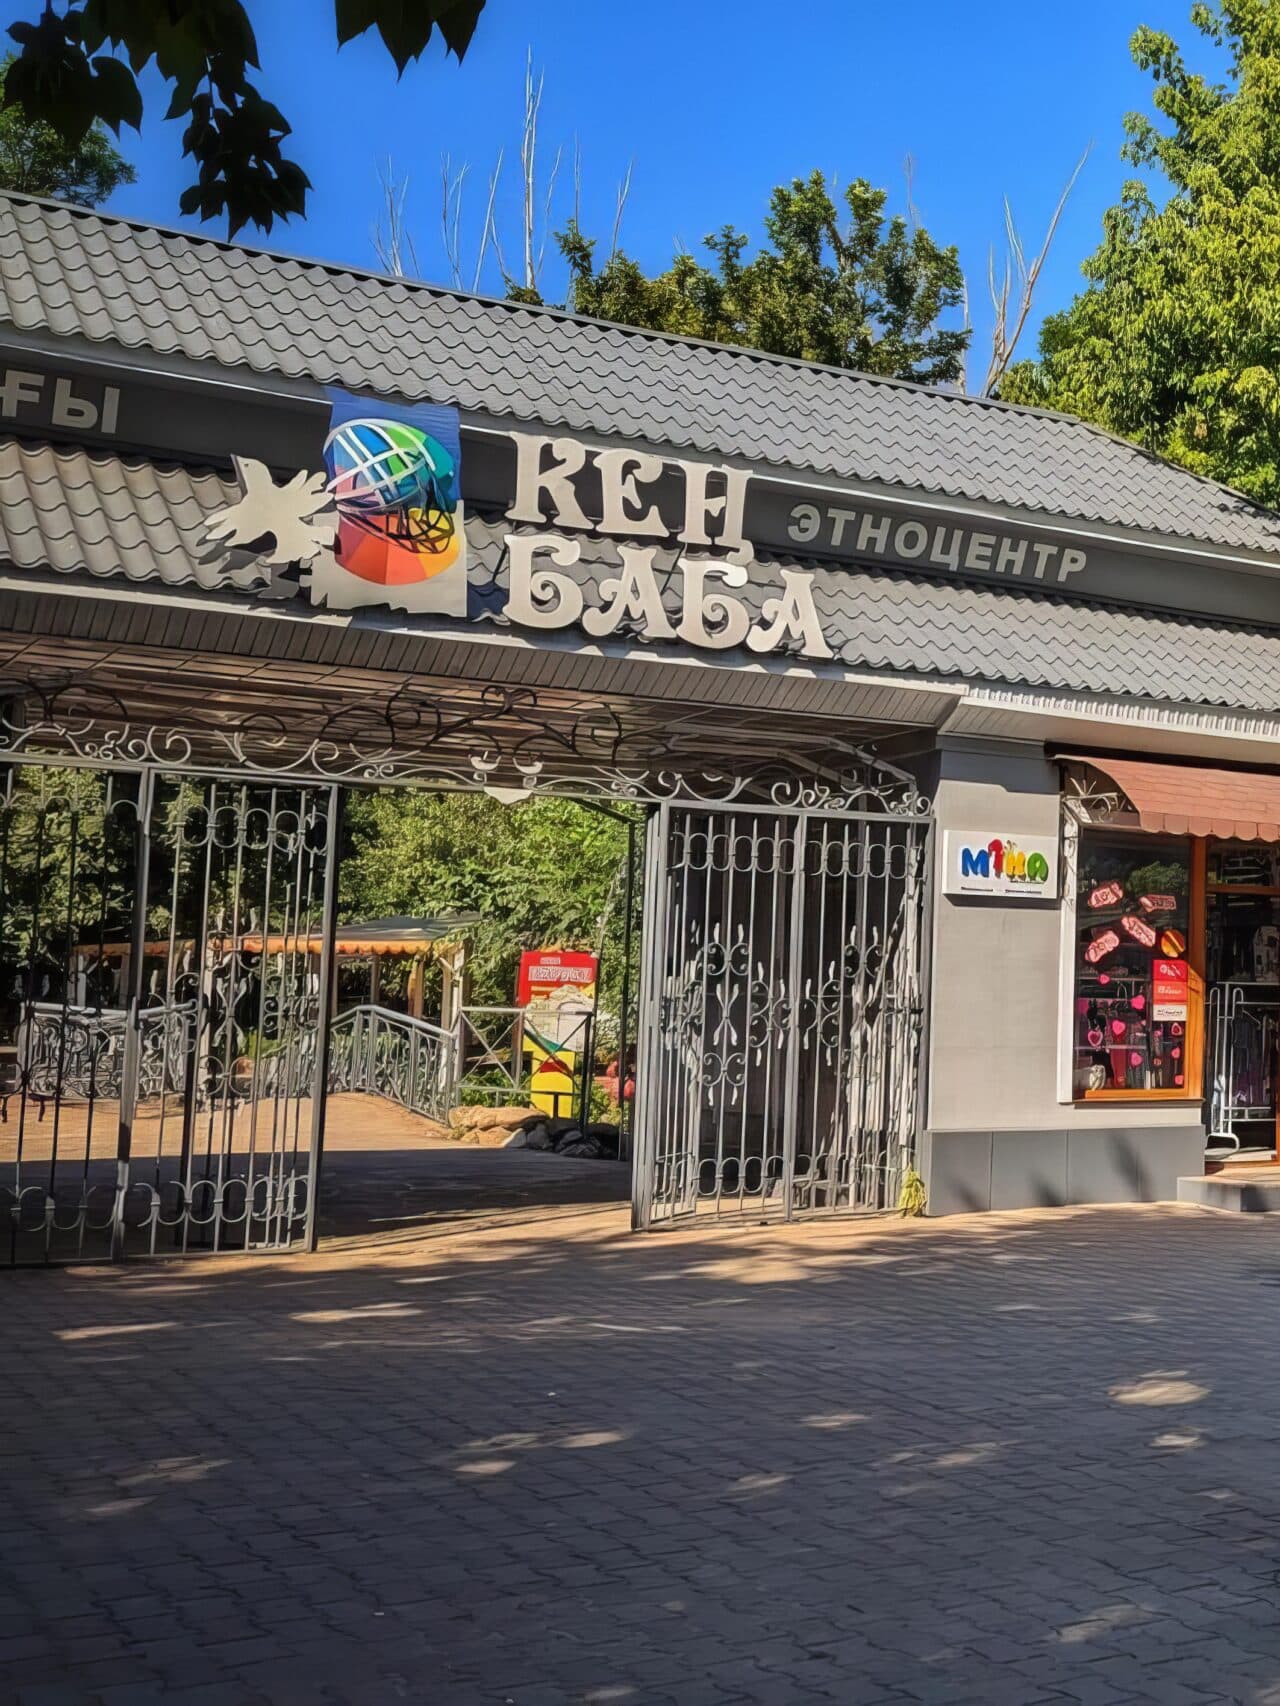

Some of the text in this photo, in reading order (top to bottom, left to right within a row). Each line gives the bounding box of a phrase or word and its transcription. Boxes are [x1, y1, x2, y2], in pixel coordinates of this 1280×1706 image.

[504, 431, 754, 565] КЕҢ
[787, 503, 1087, 583] ЭТНОЦЕНТР
[502, 533, 834, 658] БАБА
